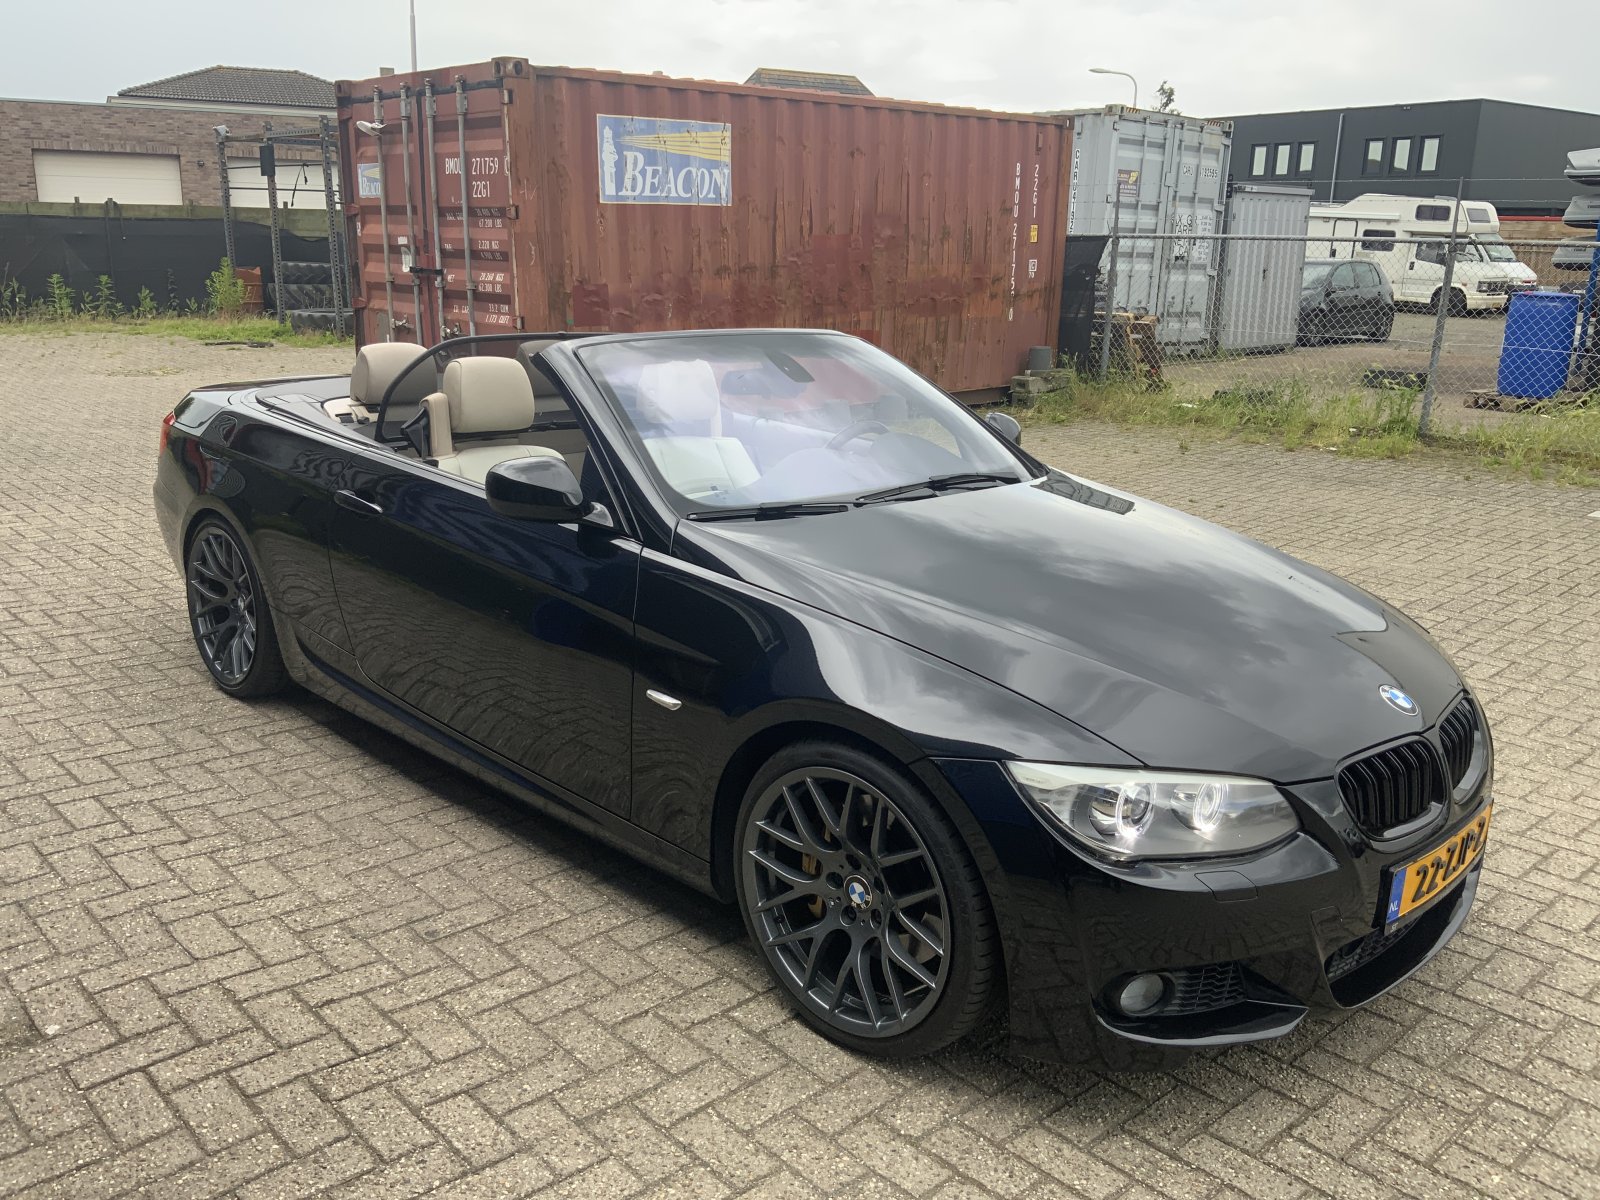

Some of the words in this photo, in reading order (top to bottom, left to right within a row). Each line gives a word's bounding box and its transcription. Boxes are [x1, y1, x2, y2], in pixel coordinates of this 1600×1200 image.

[472, 157, 499, 175] 271759
[618, 151, 730, 200] BEACON
[472, 180, 491, 198] 22G1
[1031, 164, 1039, 218] 22G1
[1388, 902, 1399, 913] NL
